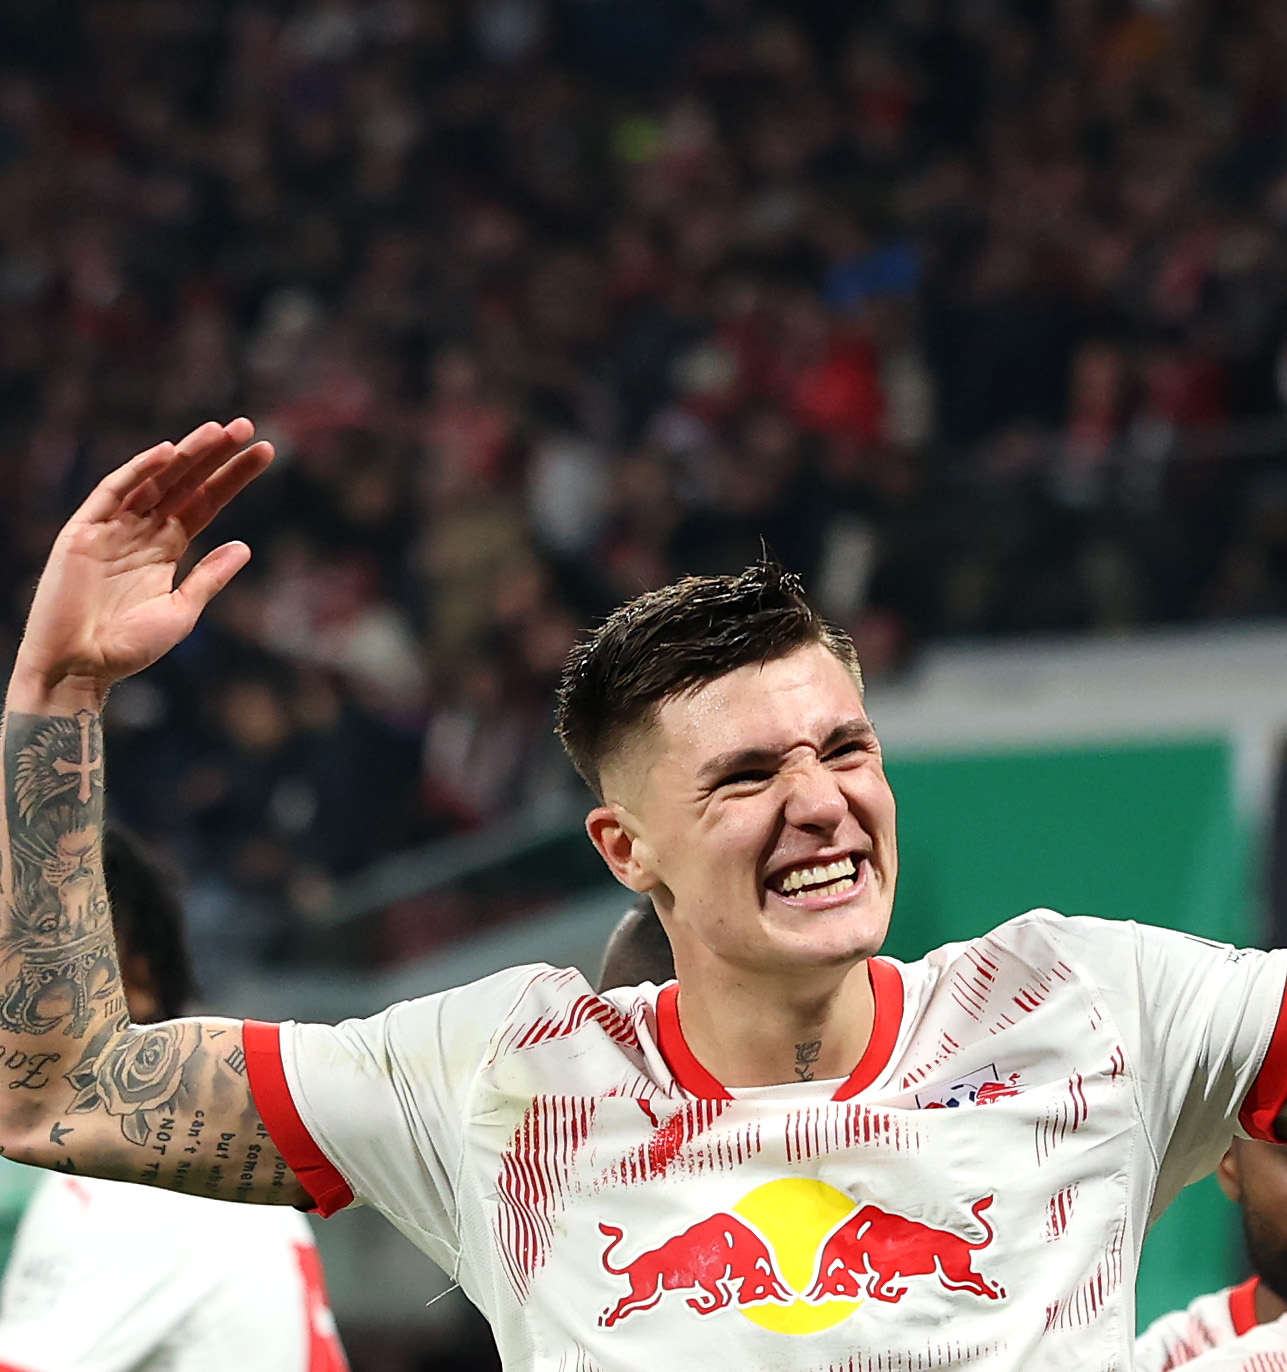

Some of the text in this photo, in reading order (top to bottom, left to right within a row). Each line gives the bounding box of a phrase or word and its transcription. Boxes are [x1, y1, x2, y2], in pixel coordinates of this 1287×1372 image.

[153, 1118, 175, 1155] NOT
[184, 1110, 205, 1154] can't
[215, 1133, 236, 1159] but
